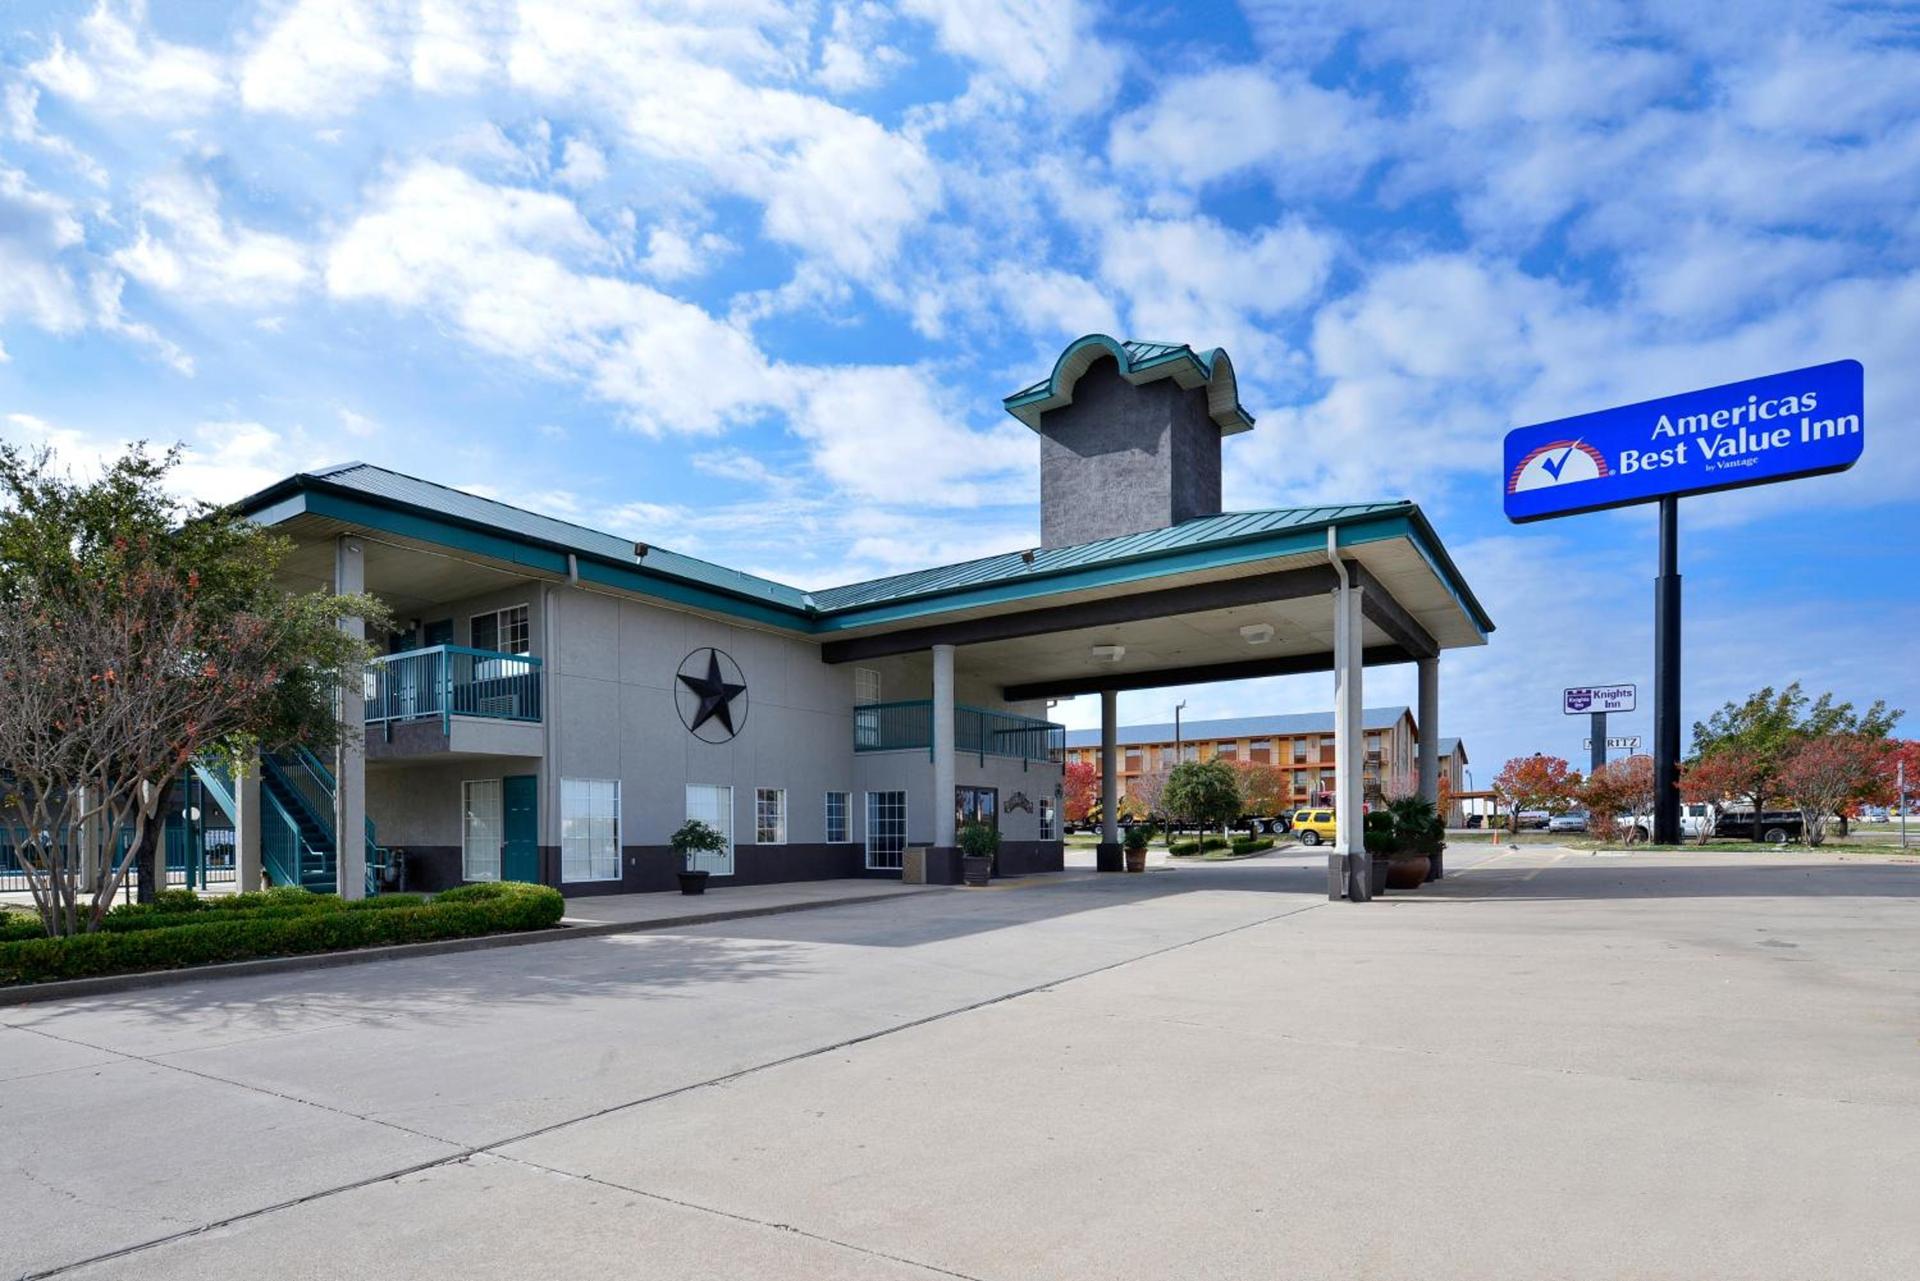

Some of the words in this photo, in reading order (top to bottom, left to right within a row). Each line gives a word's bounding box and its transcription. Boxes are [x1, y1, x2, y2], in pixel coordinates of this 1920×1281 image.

[1651, 391, 1817, 440] Americas
[1620, 441, 1688, 475] Best
[1696, 427, 1791, 460] Value
[1801, 414, 1859, 443] Inn
[1705, 464, 1716, 472] by
[1717, 457, 1759, 470] Vantage
[1593, 689, 1632, 700] Knights
[1605, 700, 1620, 708] Inn
[1587, 738, 1638, 748] RITZ
